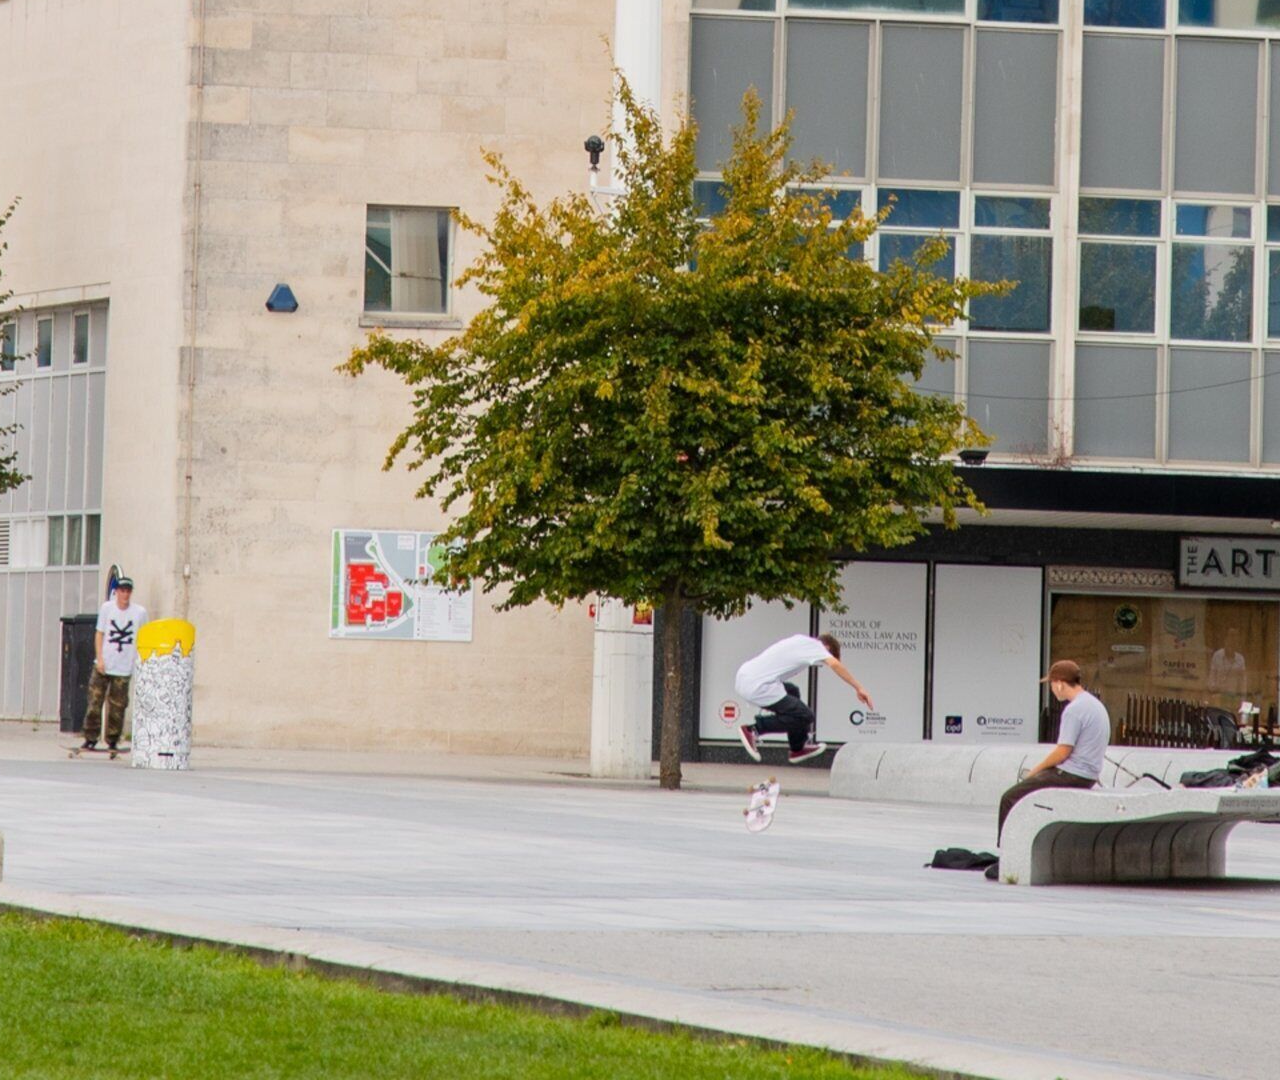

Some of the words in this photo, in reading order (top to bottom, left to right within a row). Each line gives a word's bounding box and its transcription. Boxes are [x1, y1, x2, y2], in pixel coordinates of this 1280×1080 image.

[1187, 545, 1198, 576] THE
[829, 619, 867, 629] SCHOOL
[869, 620, 881, 629] OF
[874, 631, 894, 640] LAW
[896, 631, 918, 641] AND
[840, 641, 917, 651] MMUNICATIONS
[987, 717, 1023, 725] PRINCE2
